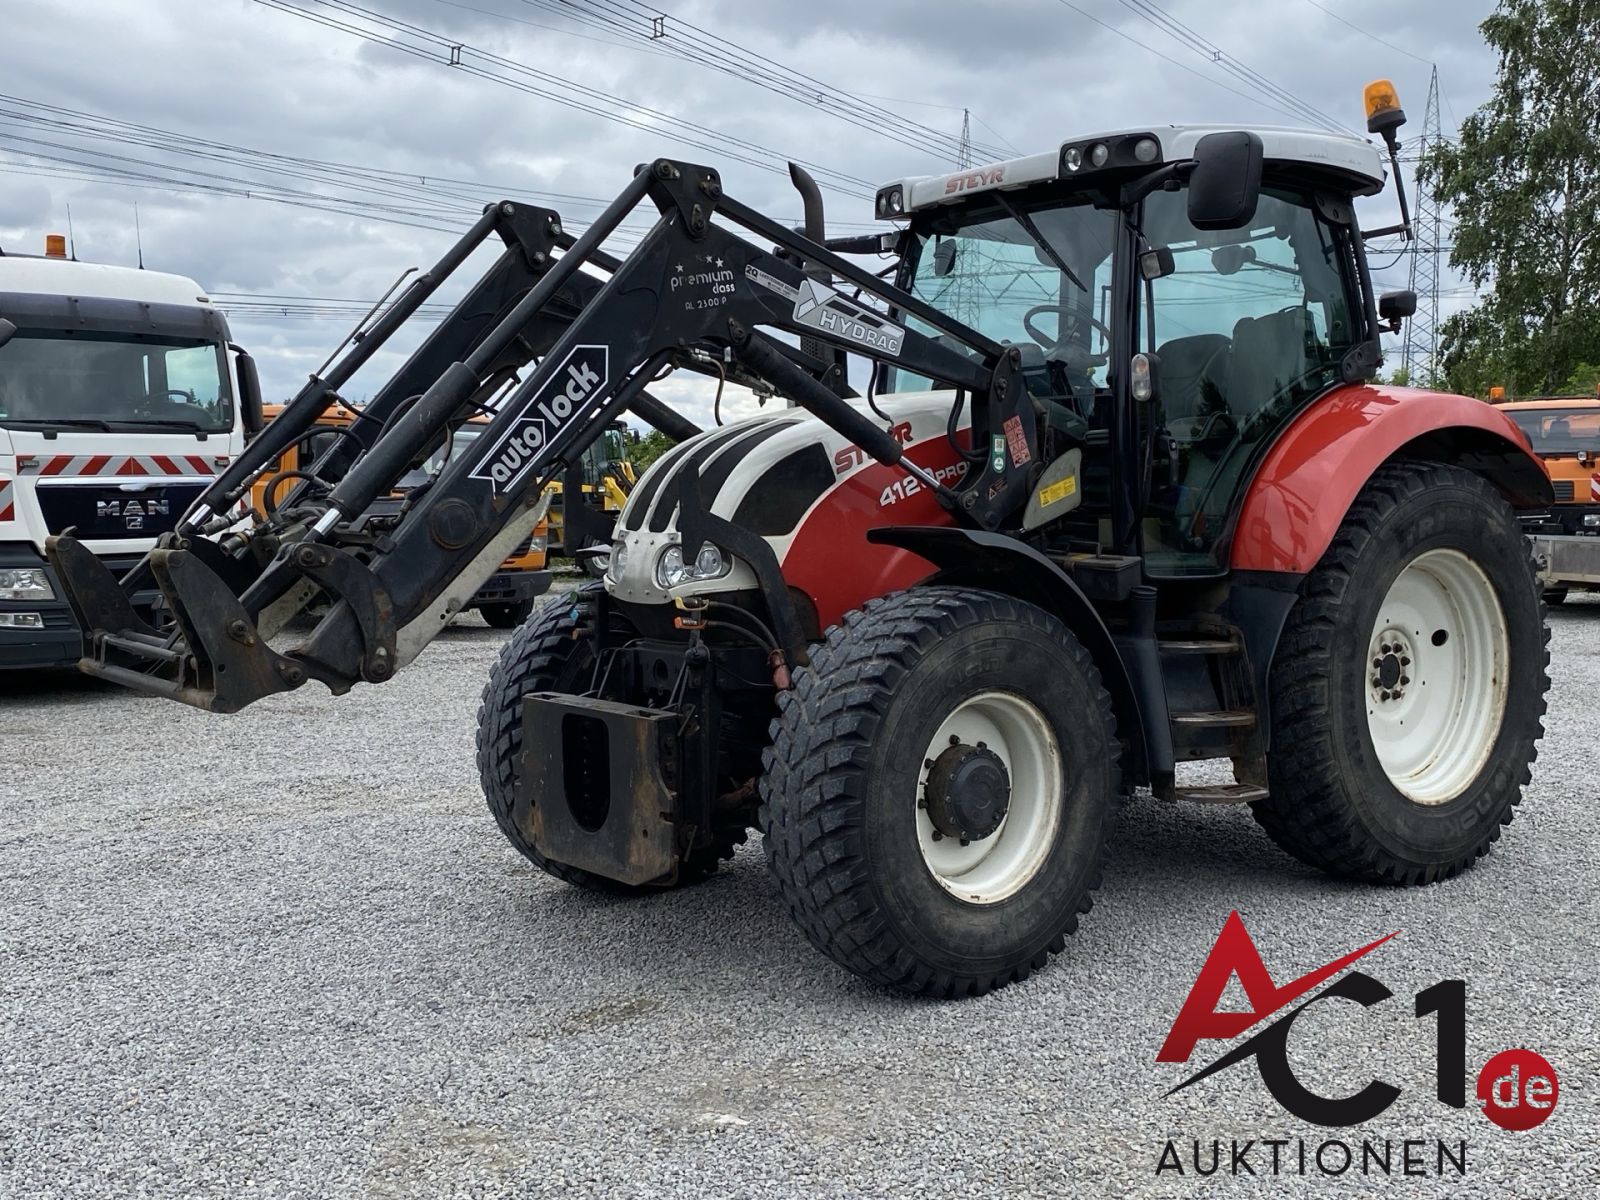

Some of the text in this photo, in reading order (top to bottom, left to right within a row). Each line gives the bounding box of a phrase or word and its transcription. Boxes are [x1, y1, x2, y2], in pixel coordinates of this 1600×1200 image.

[945, 167, 1005, 194] STEYR
[671, 270, 734, 292] premium
[712, 282, 736, 294] class
[819, 310, 899, 352] HYDRAC
[491, 361, 600, 482] auto lock
[834, 421, 913, 475] STR
[96, 499, 169, 516] MAN
